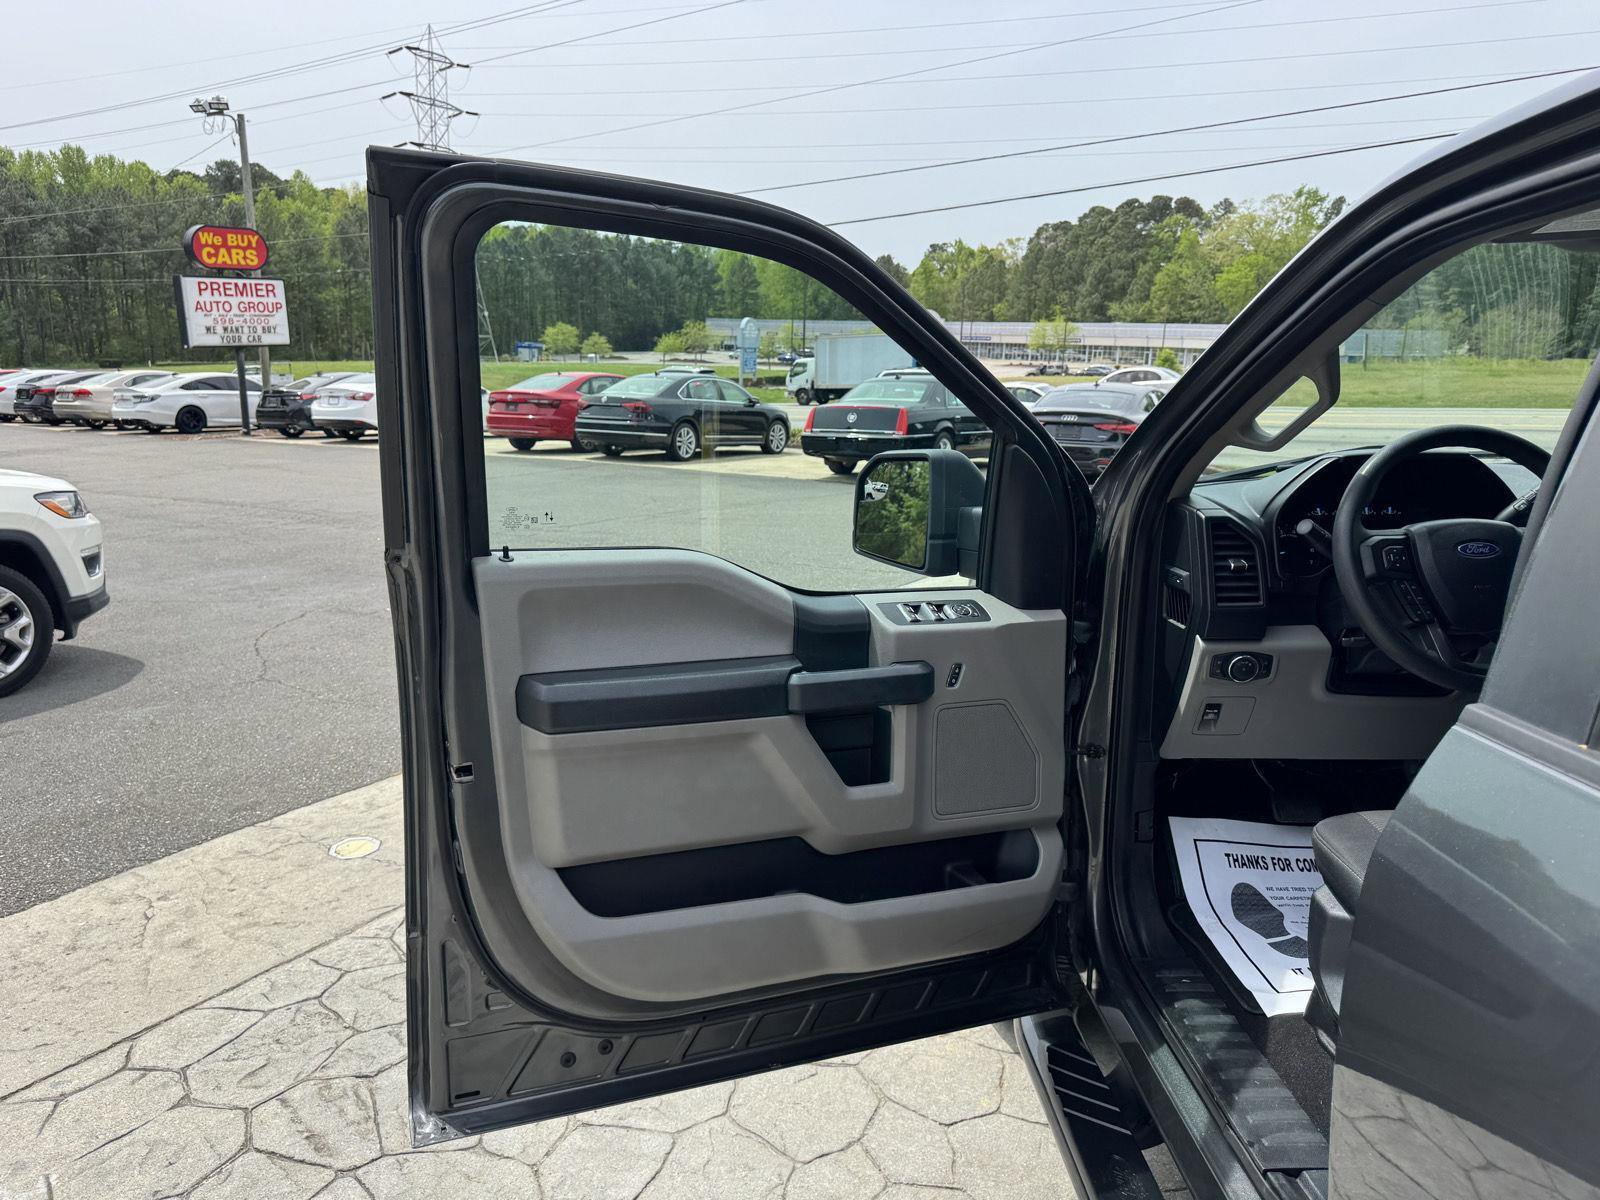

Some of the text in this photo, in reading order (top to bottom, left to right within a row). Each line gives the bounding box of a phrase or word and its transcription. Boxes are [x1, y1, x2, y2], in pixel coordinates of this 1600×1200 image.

[198, 231, 260, 247] We BUY
[201, 246, 259, 266] CARS
[197, 281, 277, 298] PREMIER
[195, 300, 283, 314] AUTO GROUP
[205, 325, 277, 334] WE WANT TO BUY
[220, 335, 262, 344] YOUR CAR
[1224, 852, 1269, 871] THANKS
[1270, 856, 1295, 873] FOR
